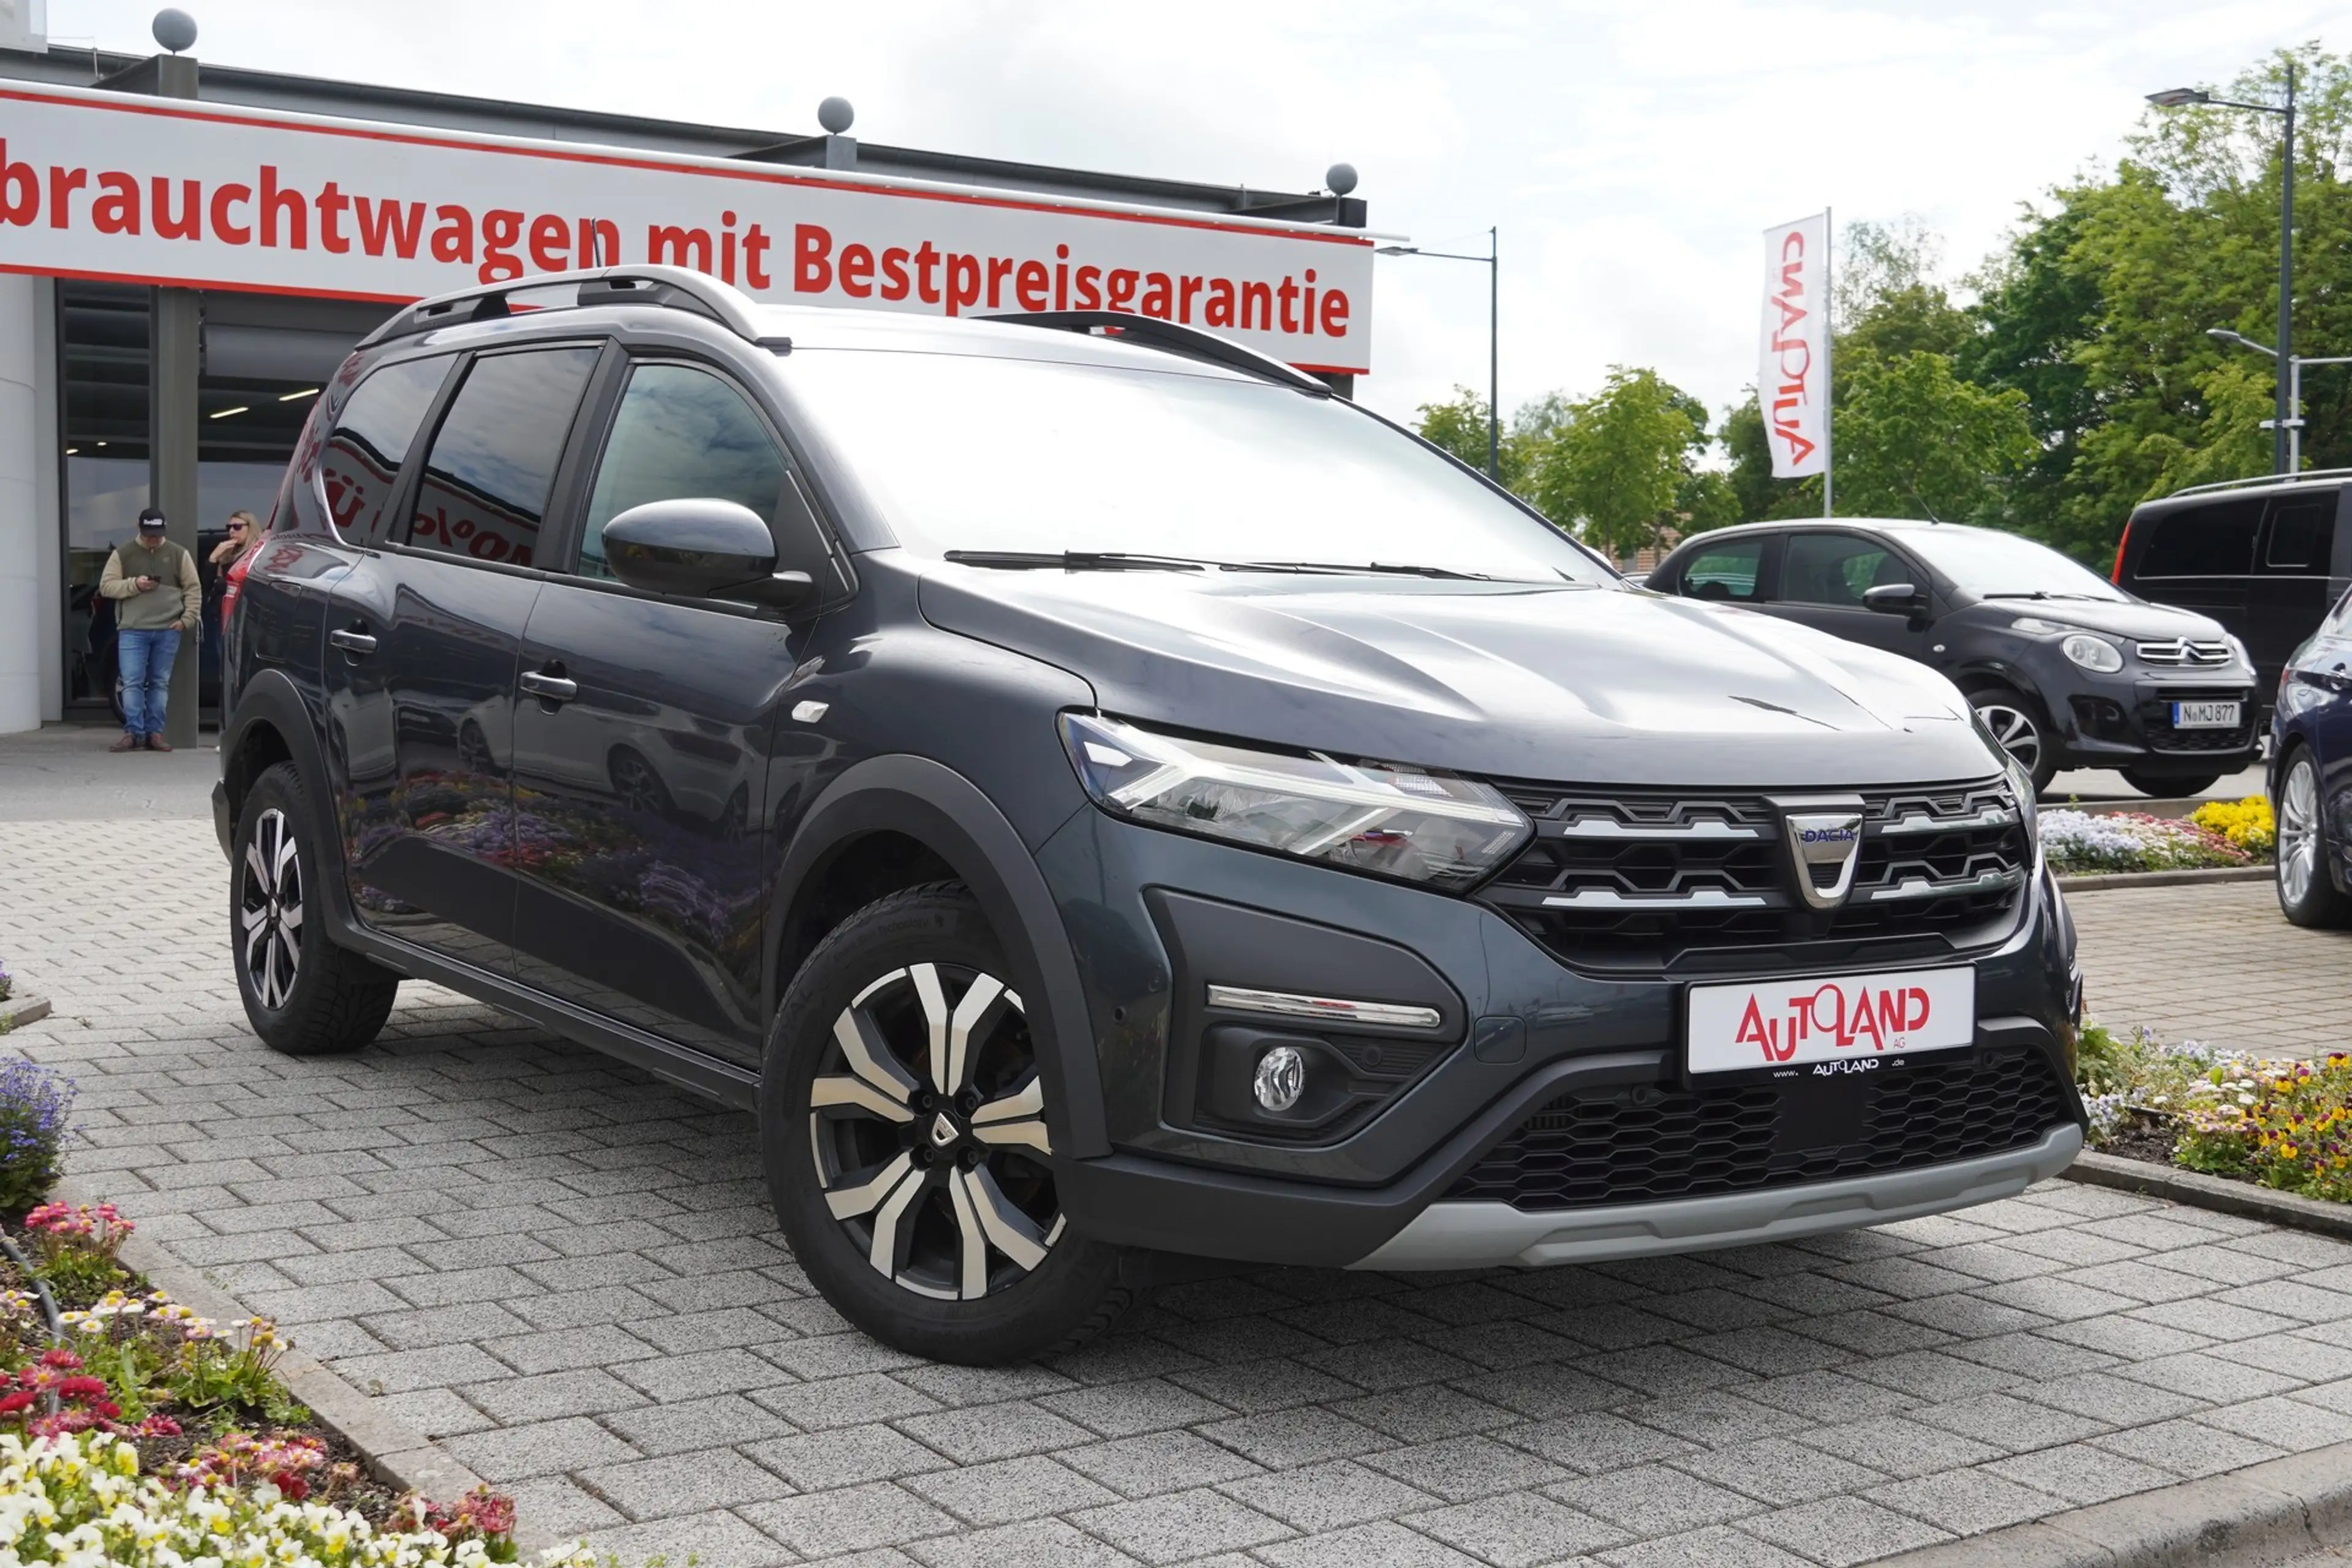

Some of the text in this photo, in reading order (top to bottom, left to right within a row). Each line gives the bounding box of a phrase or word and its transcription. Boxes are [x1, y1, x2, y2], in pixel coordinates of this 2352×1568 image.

[647, 210, 771, 290] mit
[793, 223, 1351, 338] Bestpreisgarantie
[1804, 829, 1854, 843] DACIA
[1735, 983, 1931, 1063] AUTOLAND
[1893, 1036, 1906, 1049] AG
[1812, 1058, 1880, 1077] AUTOLAND
